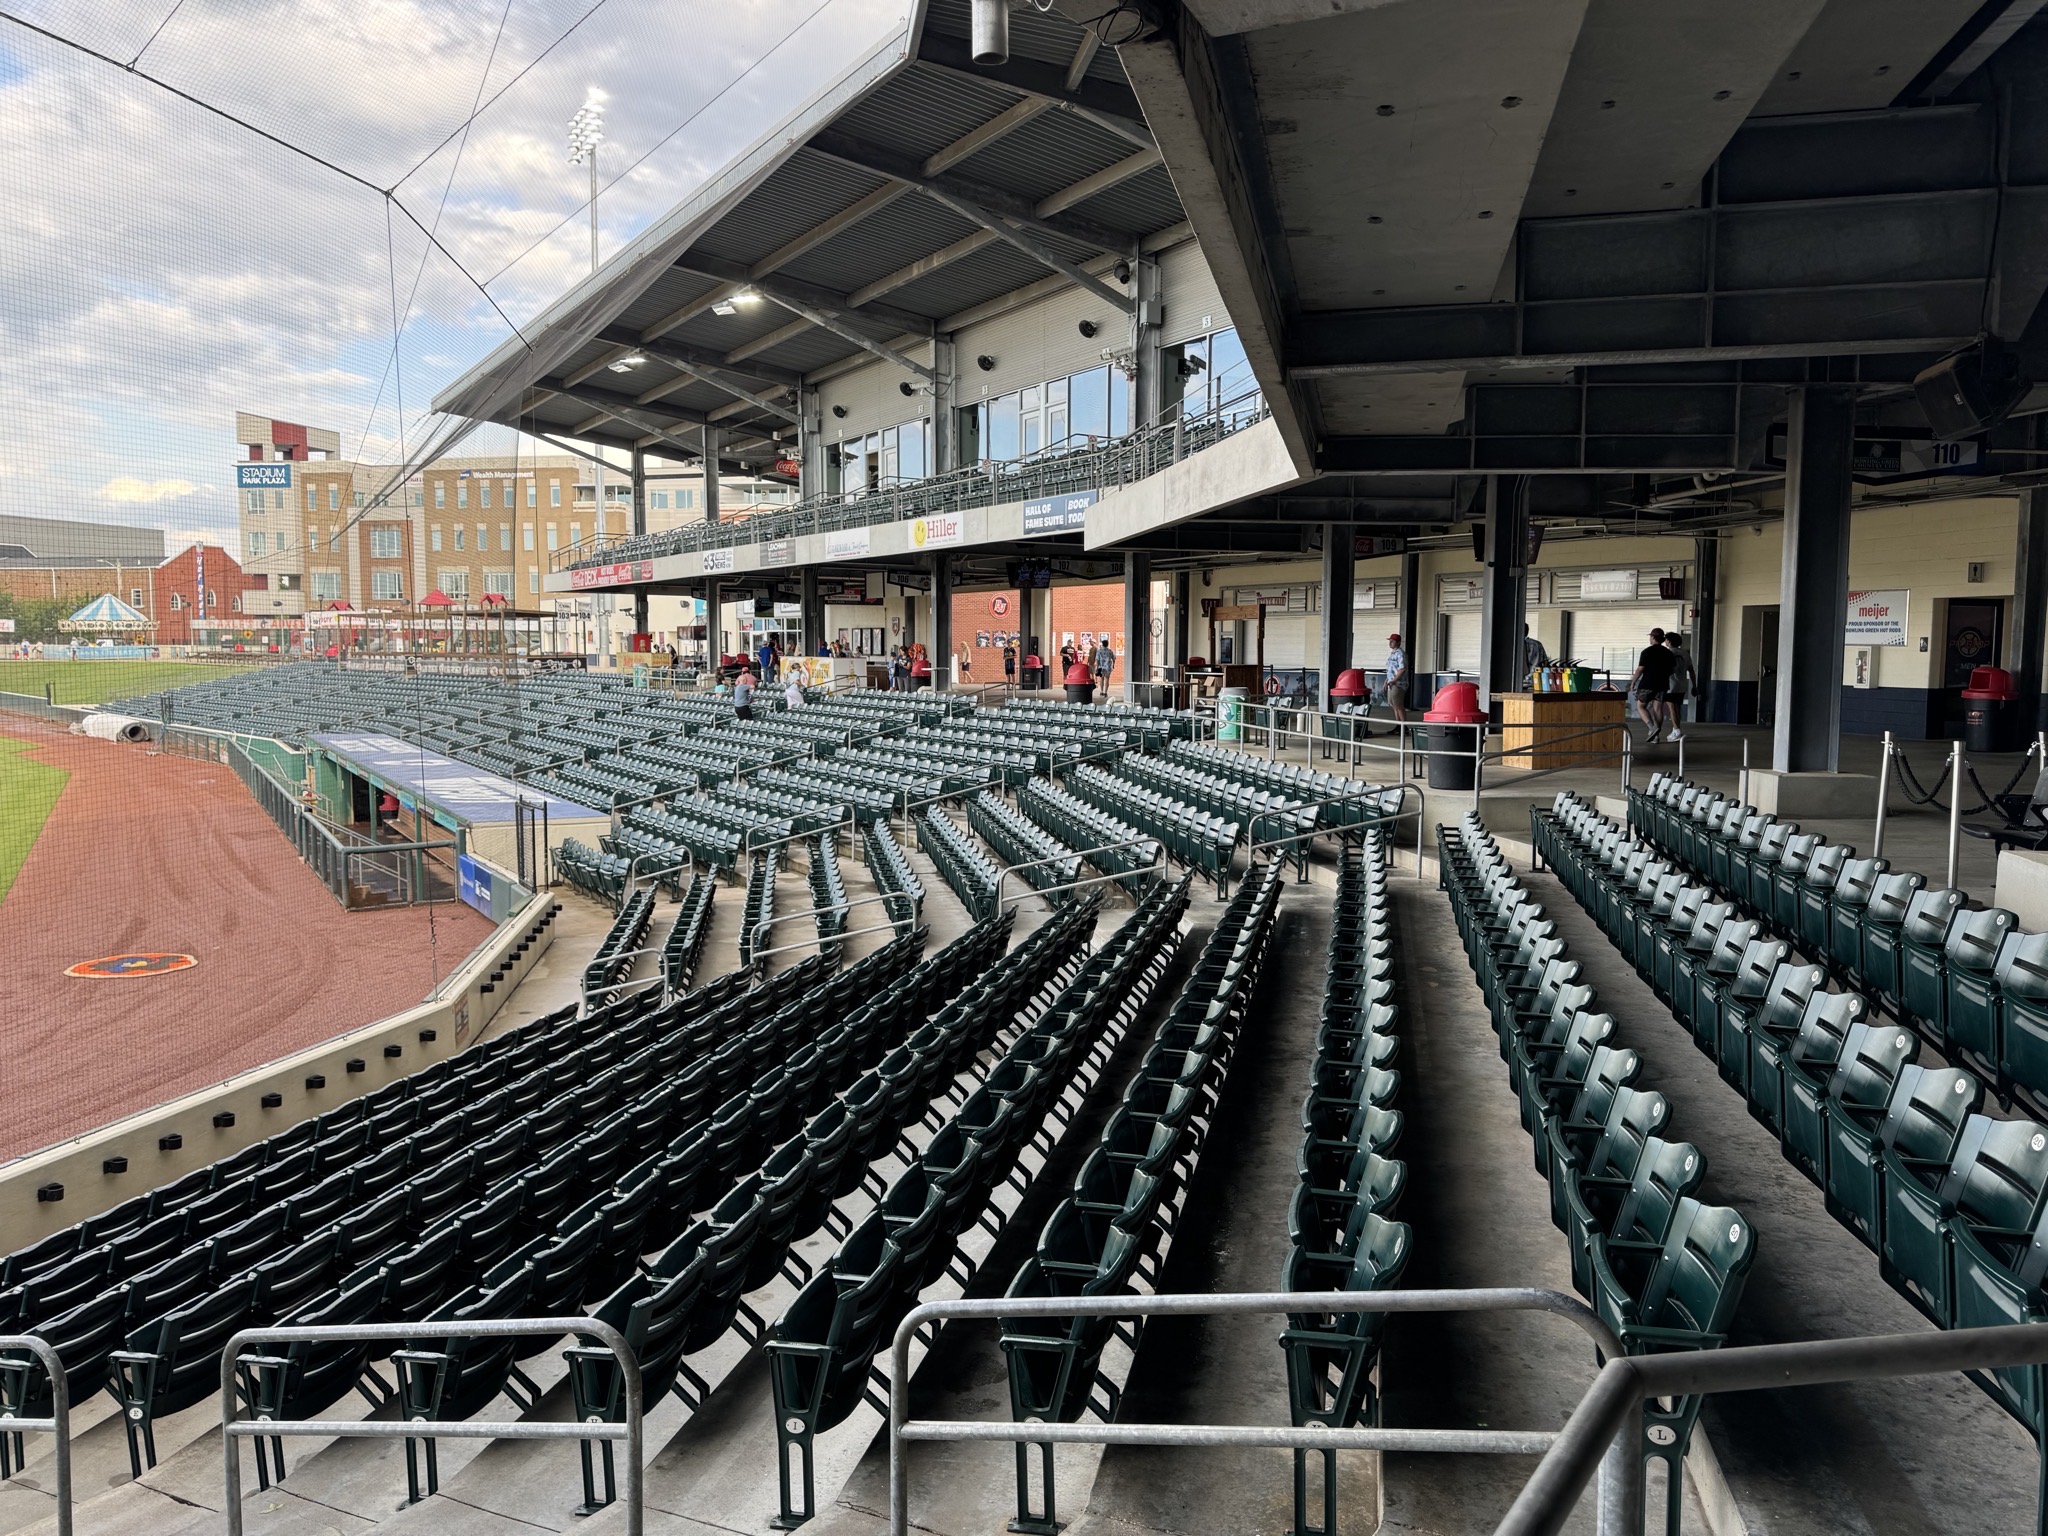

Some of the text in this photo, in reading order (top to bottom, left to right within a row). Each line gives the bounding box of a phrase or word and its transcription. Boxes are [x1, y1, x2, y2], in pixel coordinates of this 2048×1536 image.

[1932, 443, 1960, 464] 110
[242, 467, 286, 478] STADIUM
[494, 471, 535, 480] Management
[1025, 503, 1052, 517] HALL OF
[1067, 497, 1090, 511] BOOK
[1025, 514, 1064, 529] FAME SUITE
[926, 518, 958, 539] Hiller
[1381, 538, 1397, 551] 109
[1058, 561, 1070, 570] 107
[1111, 563, 1124, 572] 108
[584, 569, 598, 586] DECK
[897, 575, 909, 583] 106
[783, 584, 794, 592] 105
[1585, 581, 1609, 592] STATE
[1663, 580, 1677, 596] EAT
[558, 612, 570, 620] 103
[579, 612, 591, 620] 104
[1858, 603, 1890, 620] meijer
[1959, 662, 1977, 670] MEN
[2032, 1136, 2044, 1148] 20
[1730, 1225, 1739, 1239] 20
[1656, 1429, 1667, 1441] L
